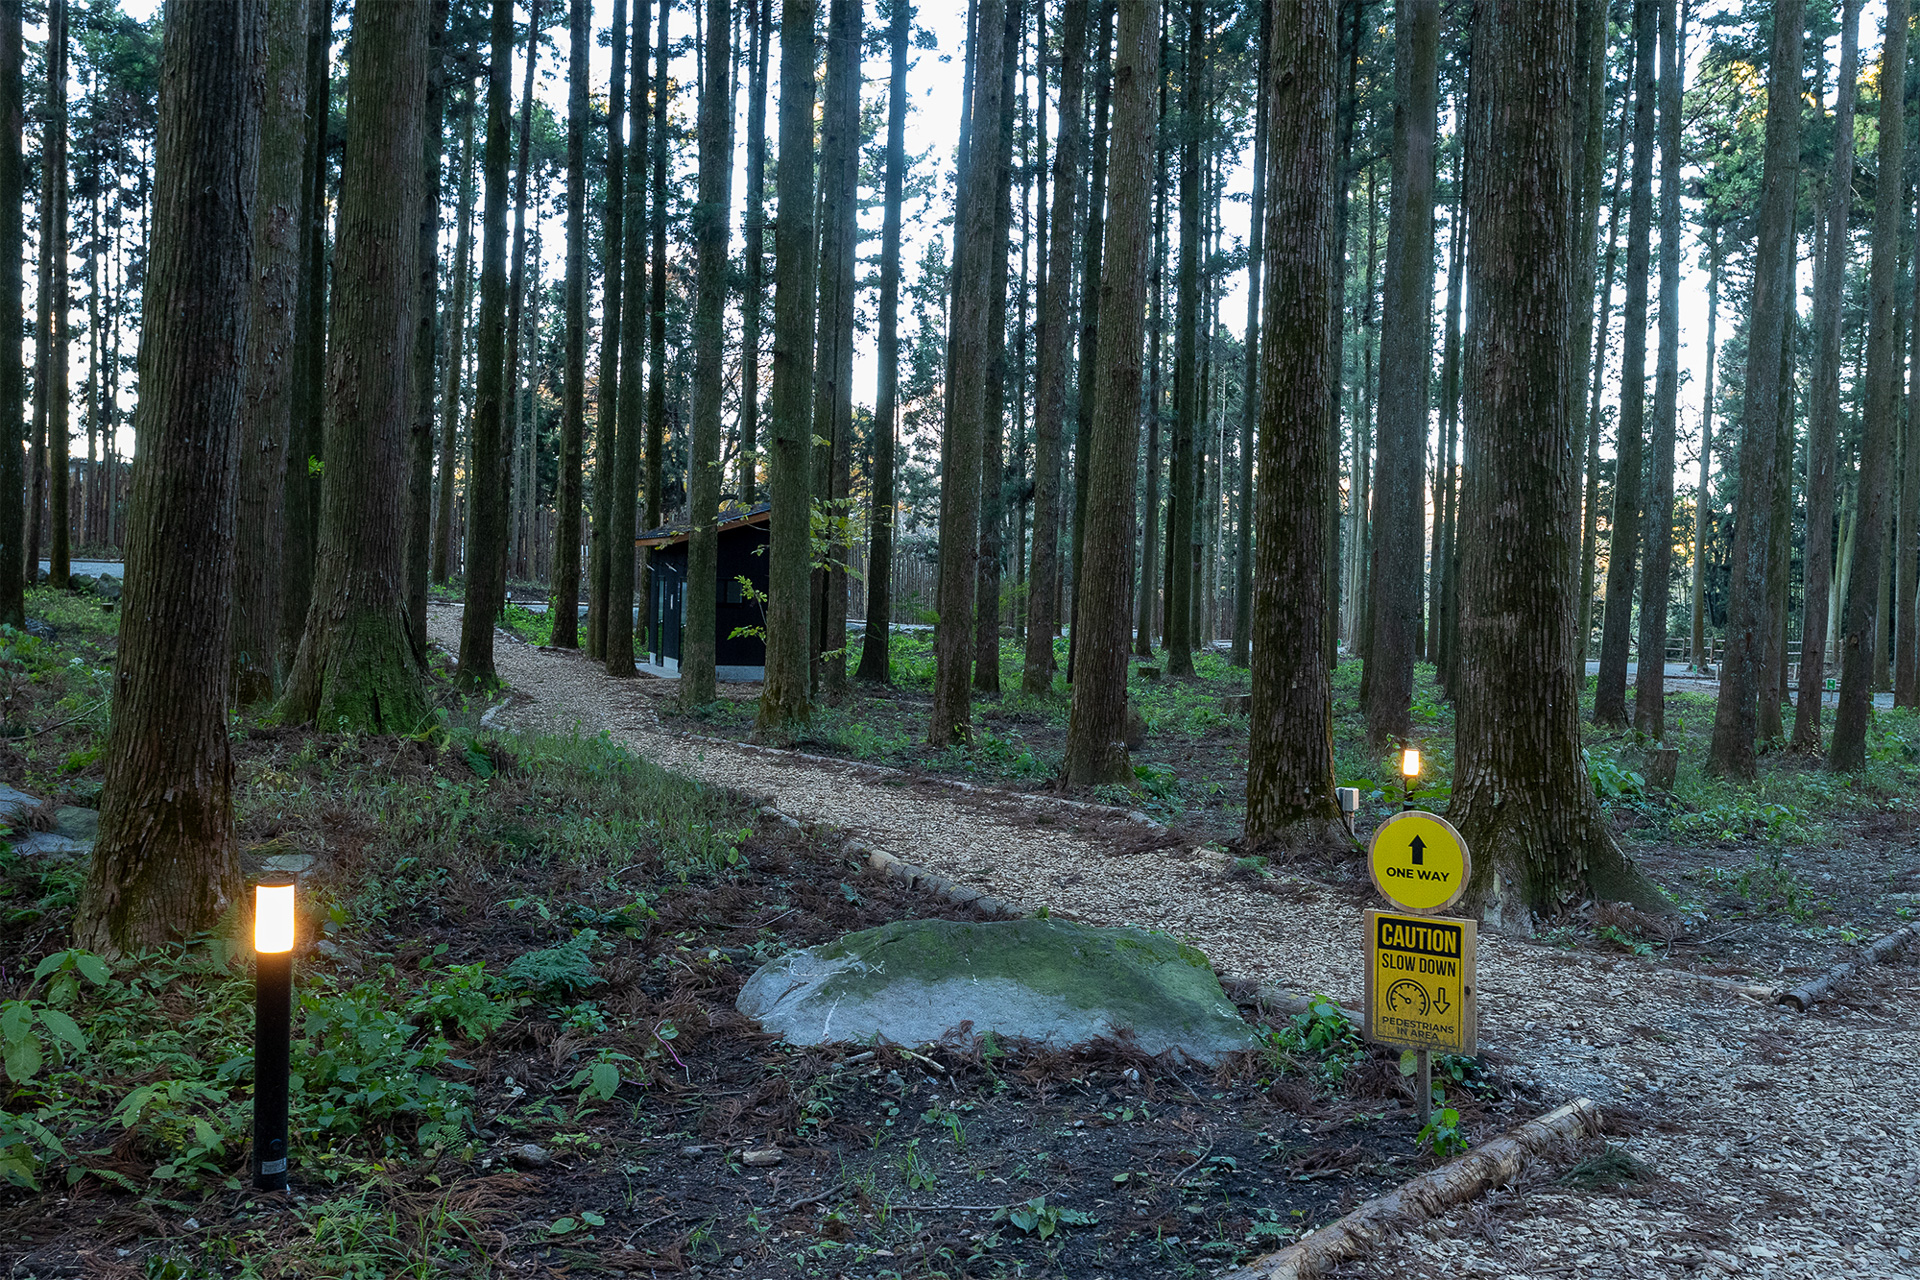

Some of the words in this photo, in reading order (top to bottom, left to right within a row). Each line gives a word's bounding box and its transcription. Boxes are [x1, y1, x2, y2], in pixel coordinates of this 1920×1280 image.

[1386, 867, 1414, 879] ONE
[1417, 870, 1450, 882] WAY
[1382, 923, 1457, 954] CAUTION
[1382, 953, 1416, 972] SLOW
[1420, 958, 1456, 977] DOWN
[1382, 1016, 1455, 1034] PEDESTRIANS
[1397, 1027, 1408, 1036] IN
[1410, 1029, 1439, 1040] AREA
